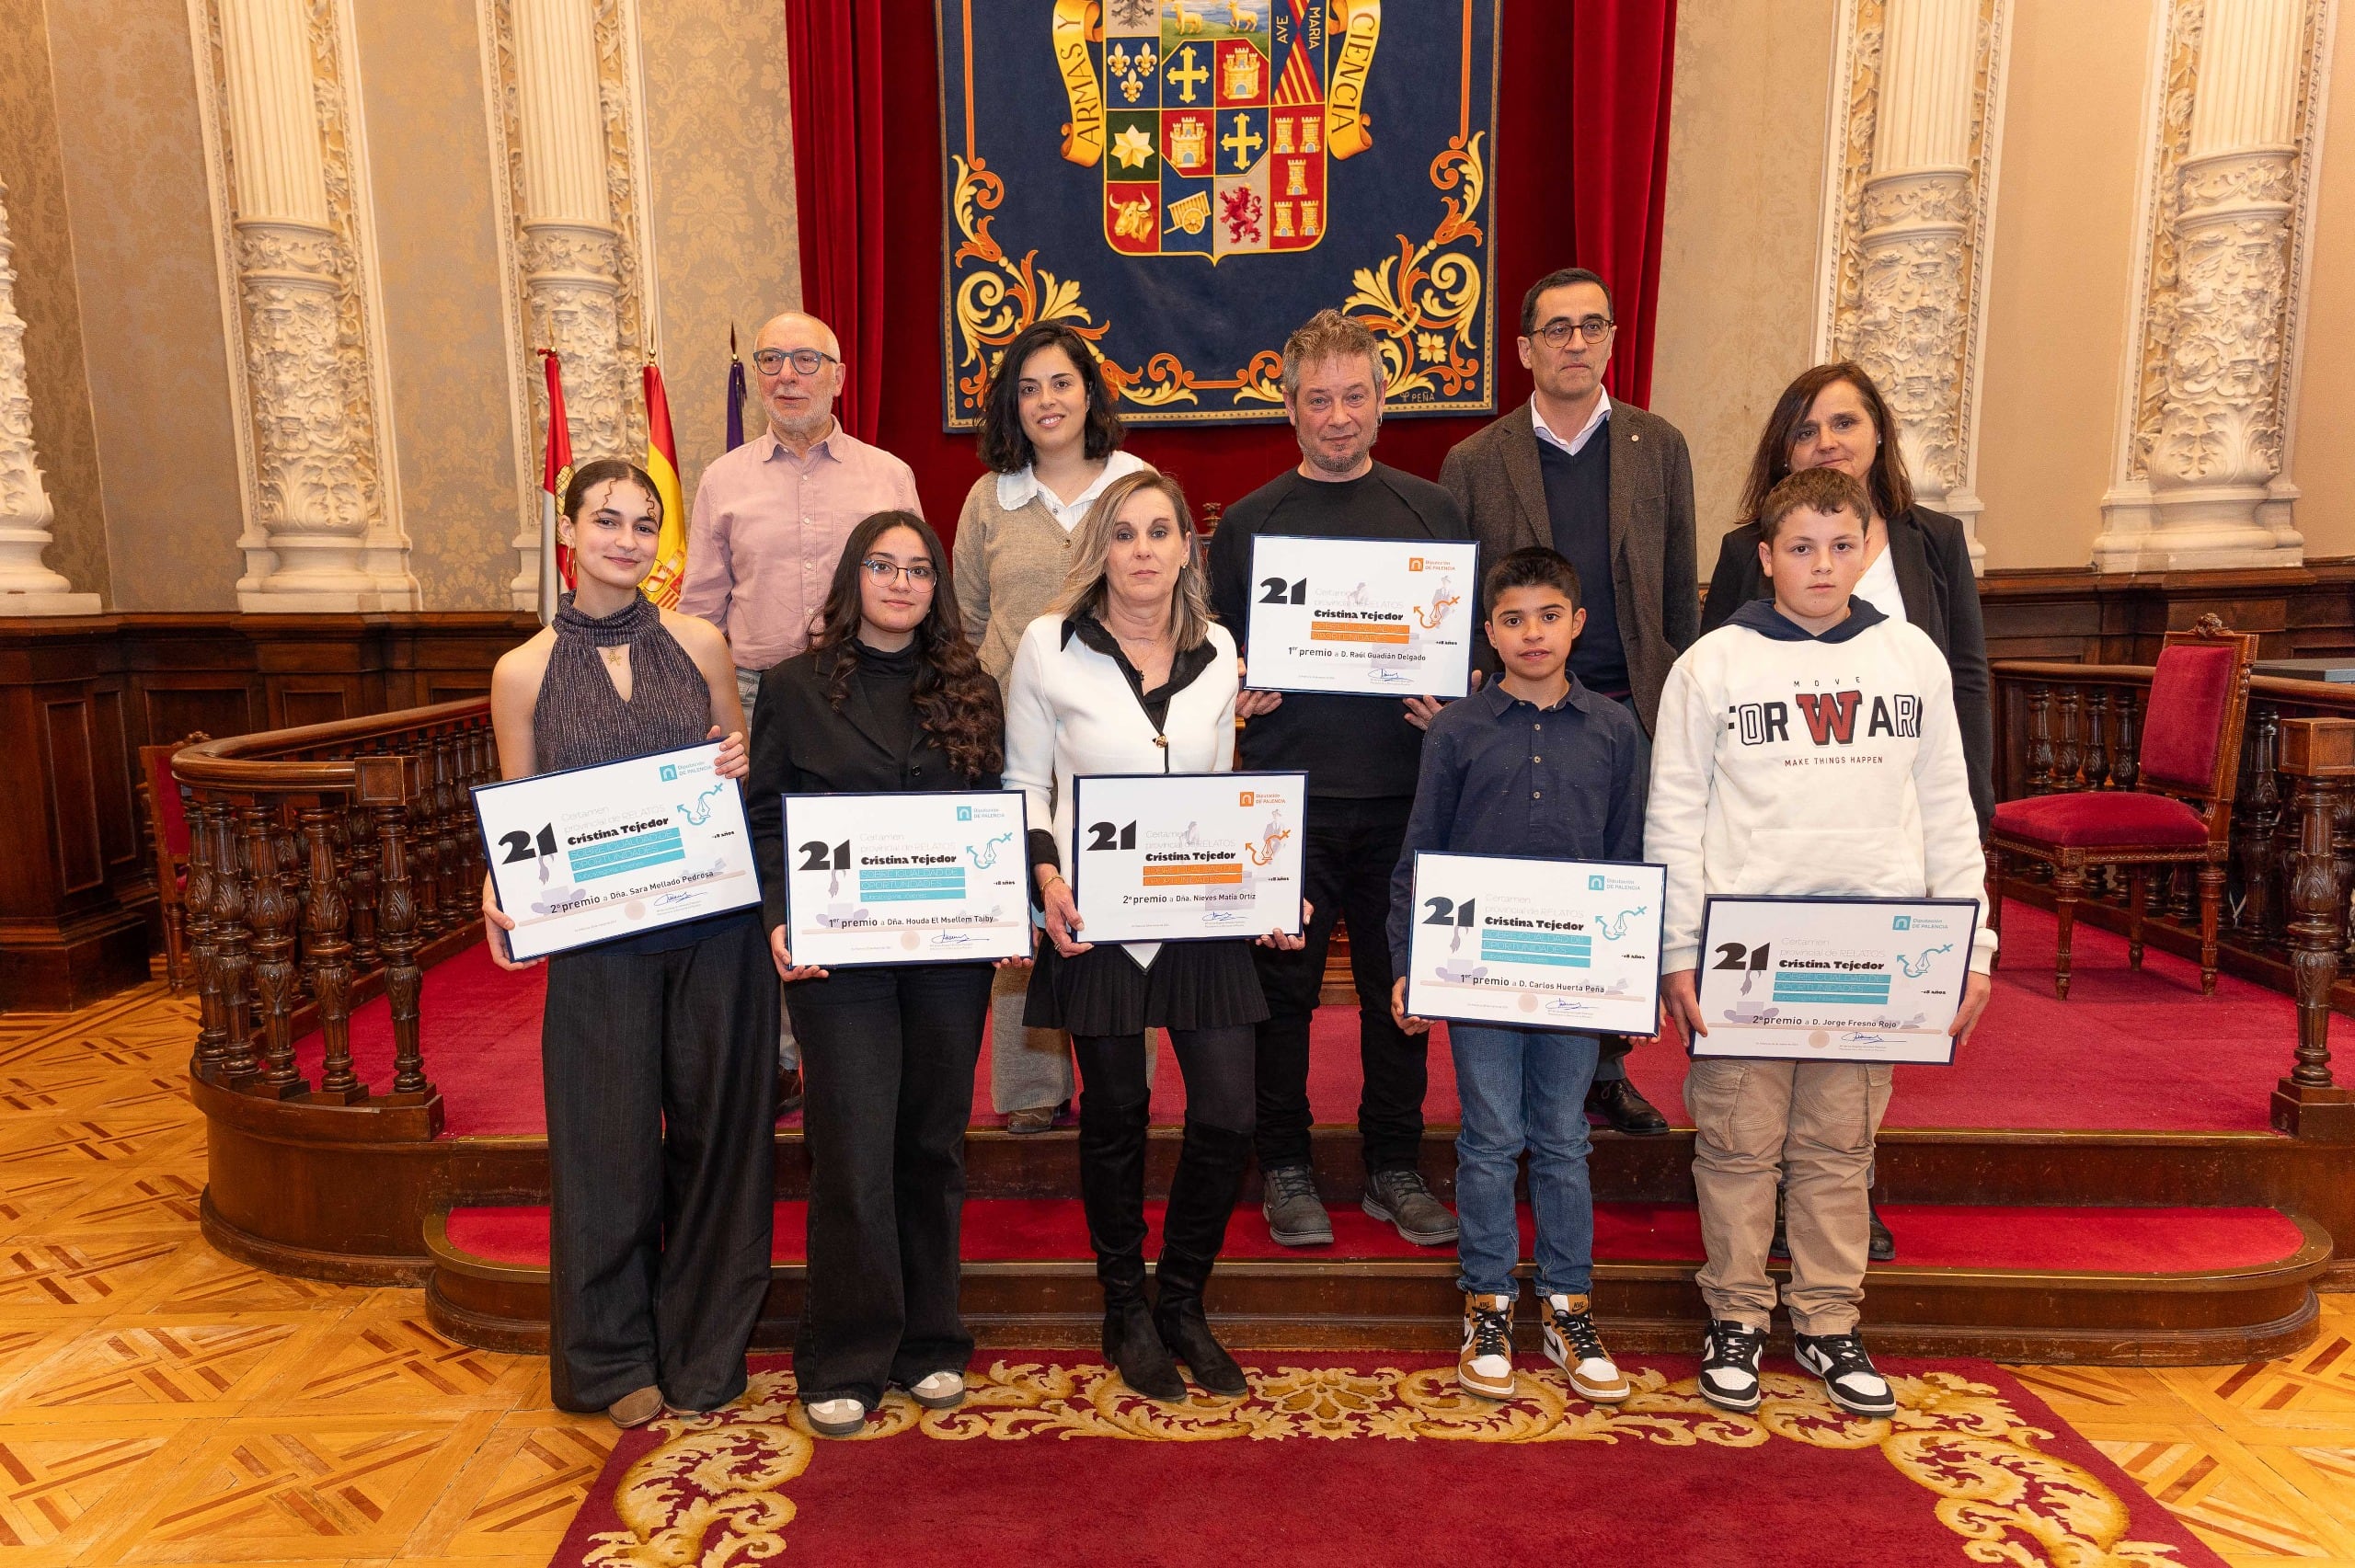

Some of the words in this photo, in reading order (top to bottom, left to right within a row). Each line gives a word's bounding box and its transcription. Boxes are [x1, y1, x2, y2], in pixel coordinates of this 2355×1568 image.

[1057, 13, 1082, 30] Y
[1276, 15, 1288, 44] AVE
[1308, 6, 1322, 51] MARIA
[1332, 12, 1375, 134] CIENCIA
[1060, 42, 1101, 146] ARMAS
[1411, 391, 1435, 402] PEÑA
[1258, 577, 1306, 604] 21
[1314, 609, 1359, 620] Cristina
[1360, 611, 1404, 623] Tejedor
[1299, 647, 1333, 658] premio
[1350, 649, 1366, 658] Raúl
[1367, 651, 1396, 660] Guadián
[1397, 653, 1426, 662] Delgado
[1793, 676, 1861, 688] MOVE
[1785, 758, 1809, 767] MAKE
[1813, 756, 1846, 765] THINGS
[1850, 756, 1883, 764] HAPPEN
[567, 828, 620, 846] Cristina
[620, 816, 670, 837] Tejedor
[1086, 819, 1137, 851] 21
[498, 821, 558, 865] 21
[798, 839, 851, 871] 21
[860, 855, 910, 866] Cristina
[911, 853, 957, 866] Tejedor
[1145, 852, 1191, 862] Cristina
[1192, 851, 1236, 863] Tejedor
[561, 894, 601, 915] premio
[610, 889, 628, 900] Dña.
[629, 885, 649, 896] Sara
[649, 877, 682, 892] Mellado
[682, 870, 714, 883] Pedrosa
[1132, 894, 1167, 905] premio
[1193, 894, 1217, 902] Nieves
[1239, 892, 1256, 900] Ortiz
[1421, 896, 1476, 928] 21
[841, 916, 878, 930] premio
[887, 918, 904, 926] Dña.
[906, 916, 930, 925] Houda
[931, 916, 939, 924] El
[940, 915, 972, 924] Msellem
[973, 914, 994, 925] Taiby
[1484, 916, 1534, 928] Cristina
[1535, 920, 1584, 932] Tejedor
[1711, 942, 1771, 971] 21
[1840, 948, 1885, 958] RELATOS
[1778, 959, 1831, 969] Cristina
[1833, 960, 1885, 972] Tejedor
[1472, 974, 1510, 988] premio
[1529, 980, 1555, 990] Carlos
[1556, 983, 1584, 992] Huerta
[1585, 985, 1604, 994] Peña
[1763, 1015, 1802, 1026] premio
[1822, 1018, 1846, 1027] Jorge
[1847, 1020, 1877, 1028] Fresno
[1878, 1021, 1897, 1029] Rojo
